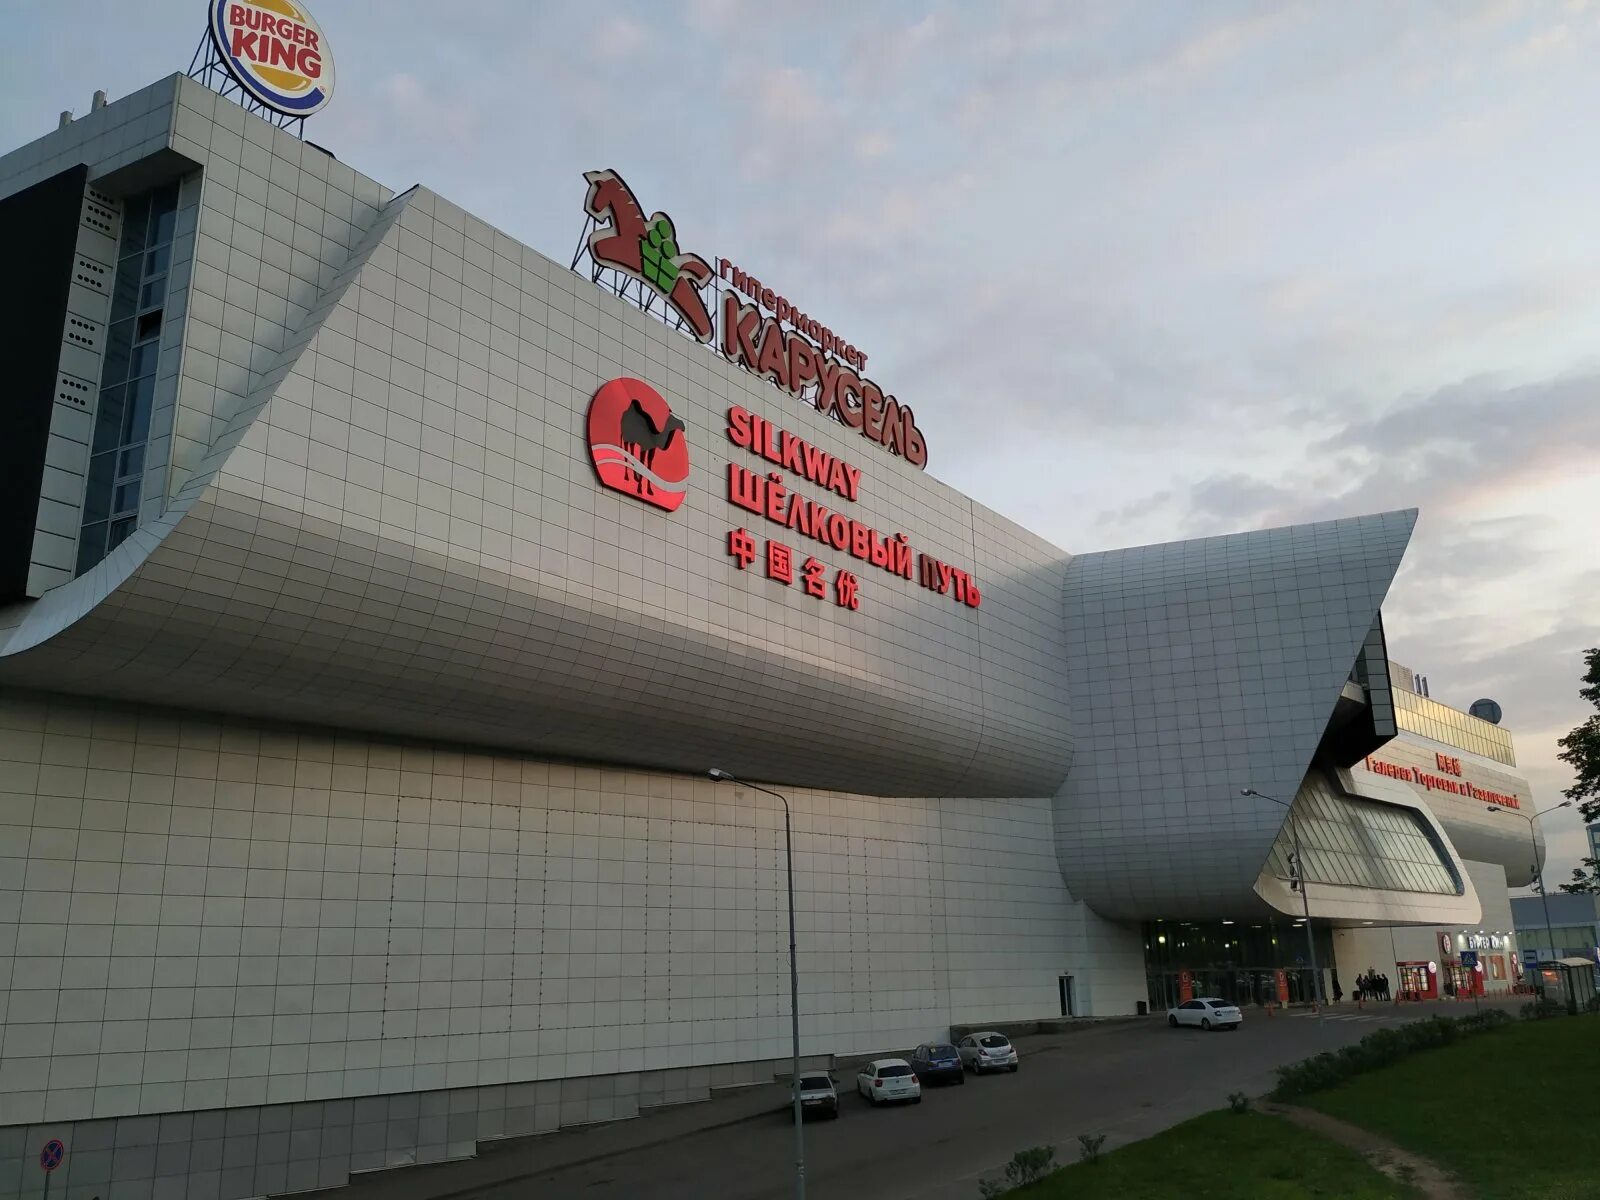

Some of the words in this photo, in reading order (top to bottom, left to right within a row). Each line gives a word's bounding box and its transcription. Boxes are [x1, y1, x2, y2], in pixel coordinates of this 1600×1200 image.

[229, 4, 319, 51] BURGER
[231, 28, 322, 79] KING
[721, 289, 928, 470] КАРУСЕЛЬ
[726, 405, 862, 502] SILKWAY
[727, 463, 913, 580] ШЁЛКОВЫЙ
[919, 553, 982, 609] ПУТЬ
[728, 527, 860, 611] 中国名优
